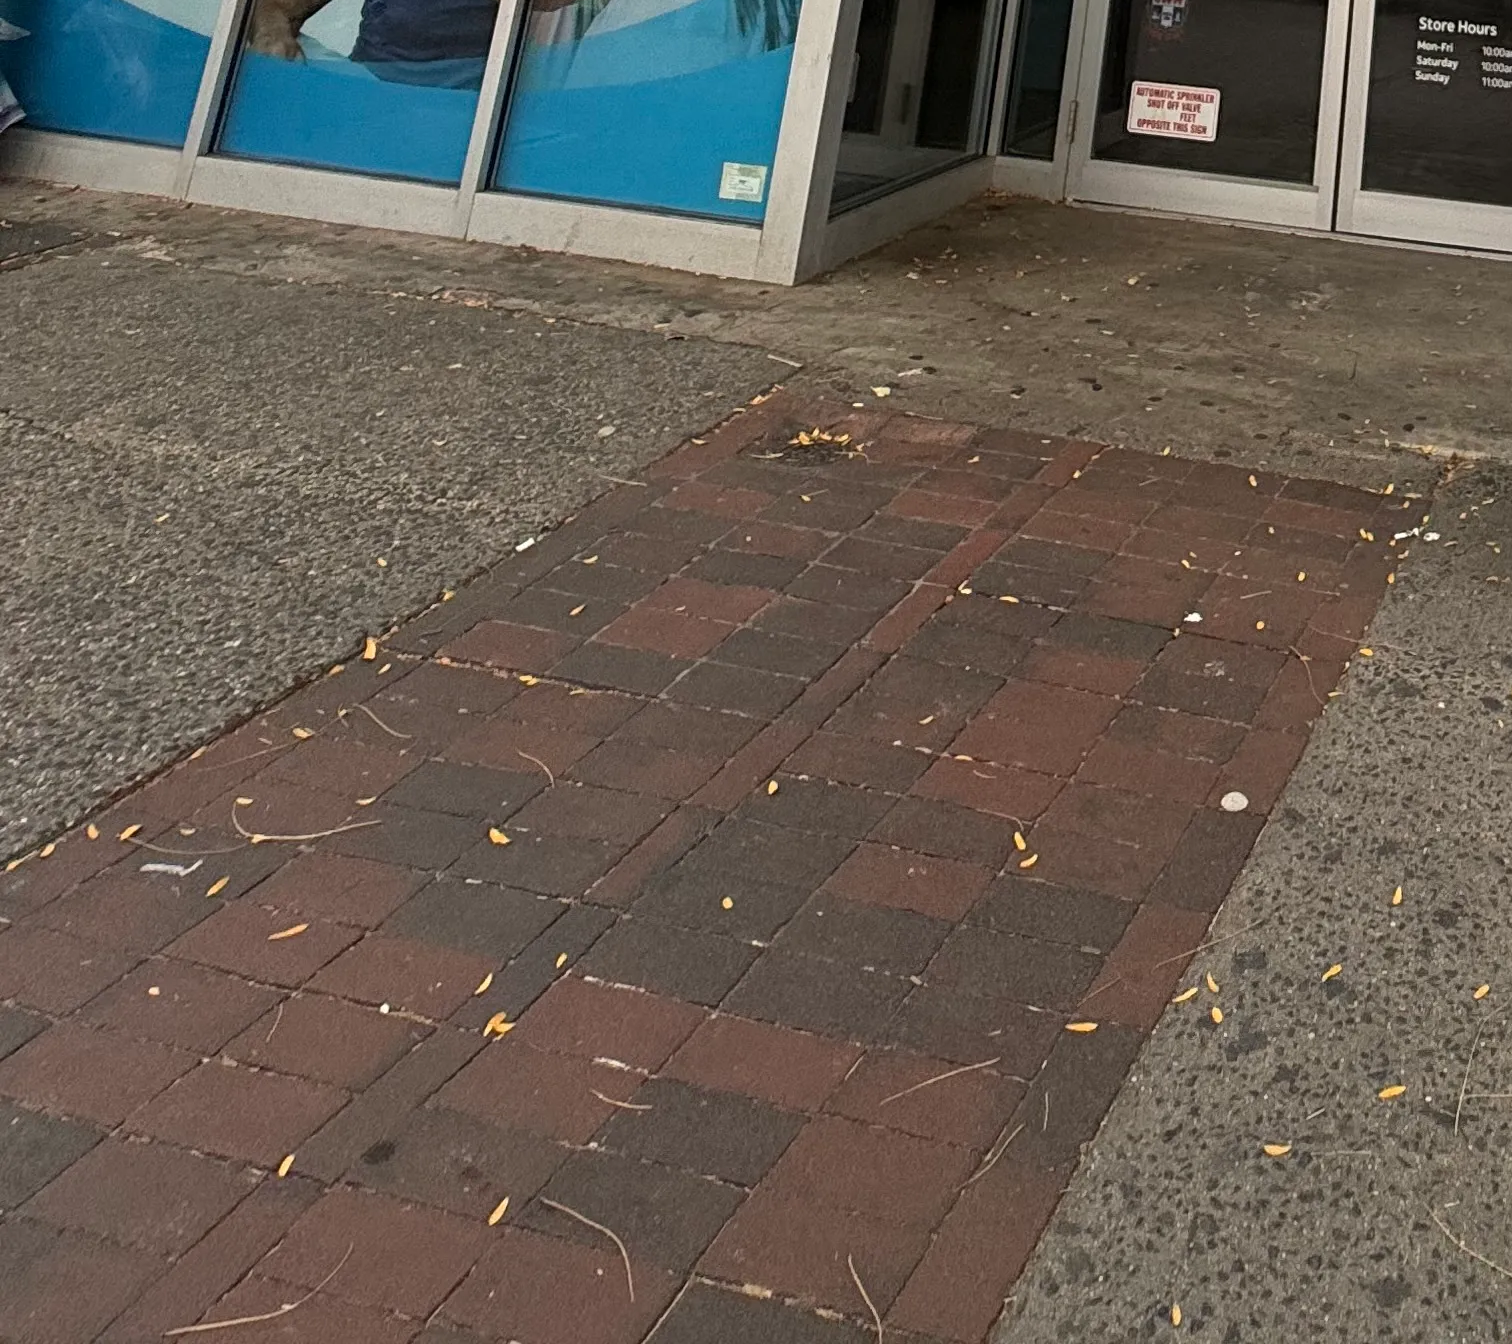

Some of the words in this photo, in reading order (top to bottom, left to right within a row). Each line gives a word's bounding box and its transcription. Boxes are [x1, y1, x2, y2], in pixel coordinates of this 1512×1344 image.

[1418, 16, 1456, 33] Store
[1457, 20, 1498, 36] Hours
[1417, 40, 1454, 53] Mon-Fri
[1416, 55, 1459, 70] Saturday
[1415, 70, 1451, 85] Sunday
[1136, 86, 1175, 100] AUTOMATIC
[1177, 91, 1215, 104] SPRINKLER
[1147, 99, 1165, 109] SHUT
[1167, 101, 1180, 111] OFF
[1181, 102, 1202, 113] VALVE
[1179, 112, 1197, 123] FEET
[1136, 118, 1171, 131] OPPOSITE
[1173, 121, 1188, 133] THIS
[1190, 124, 1207, 135] SIGN
